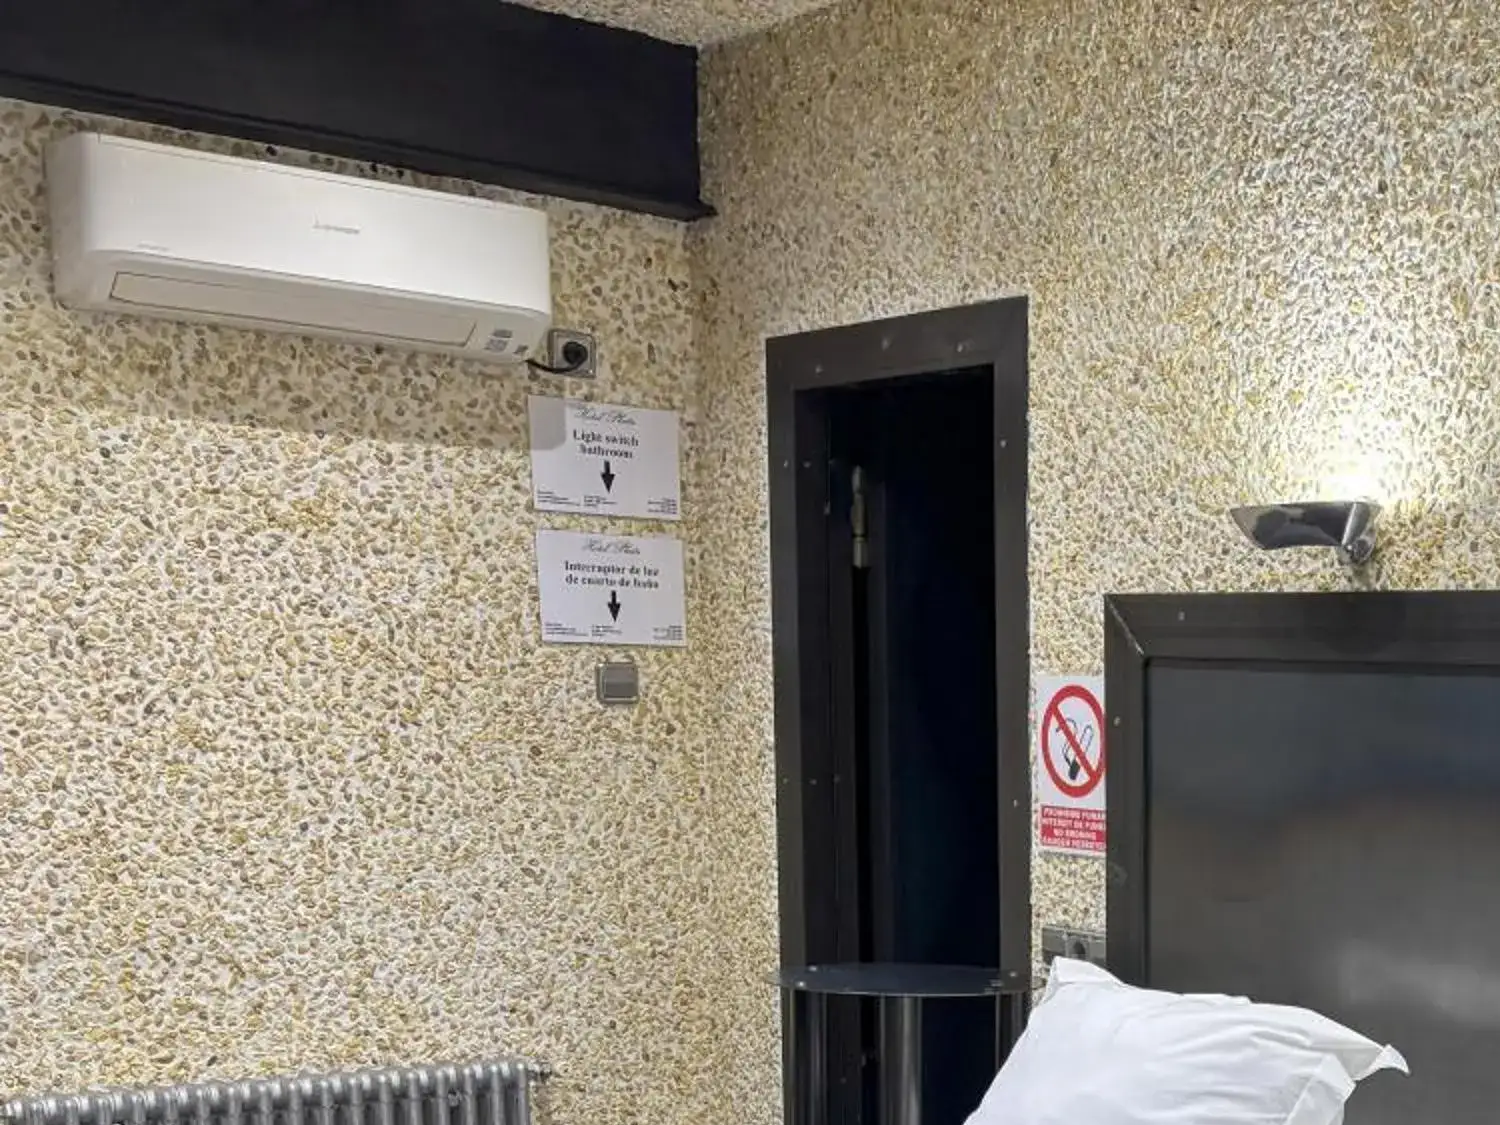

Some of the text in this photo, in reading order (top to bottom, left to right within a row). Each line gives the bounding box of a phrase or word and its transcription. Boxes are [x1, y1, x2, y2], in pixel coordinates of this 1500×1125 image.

[573, 429, 639, 447] Light switch
[629, 566, 641, 574] de
[565, 574, 579, 584] de
[619, 578, 631, 586] de
